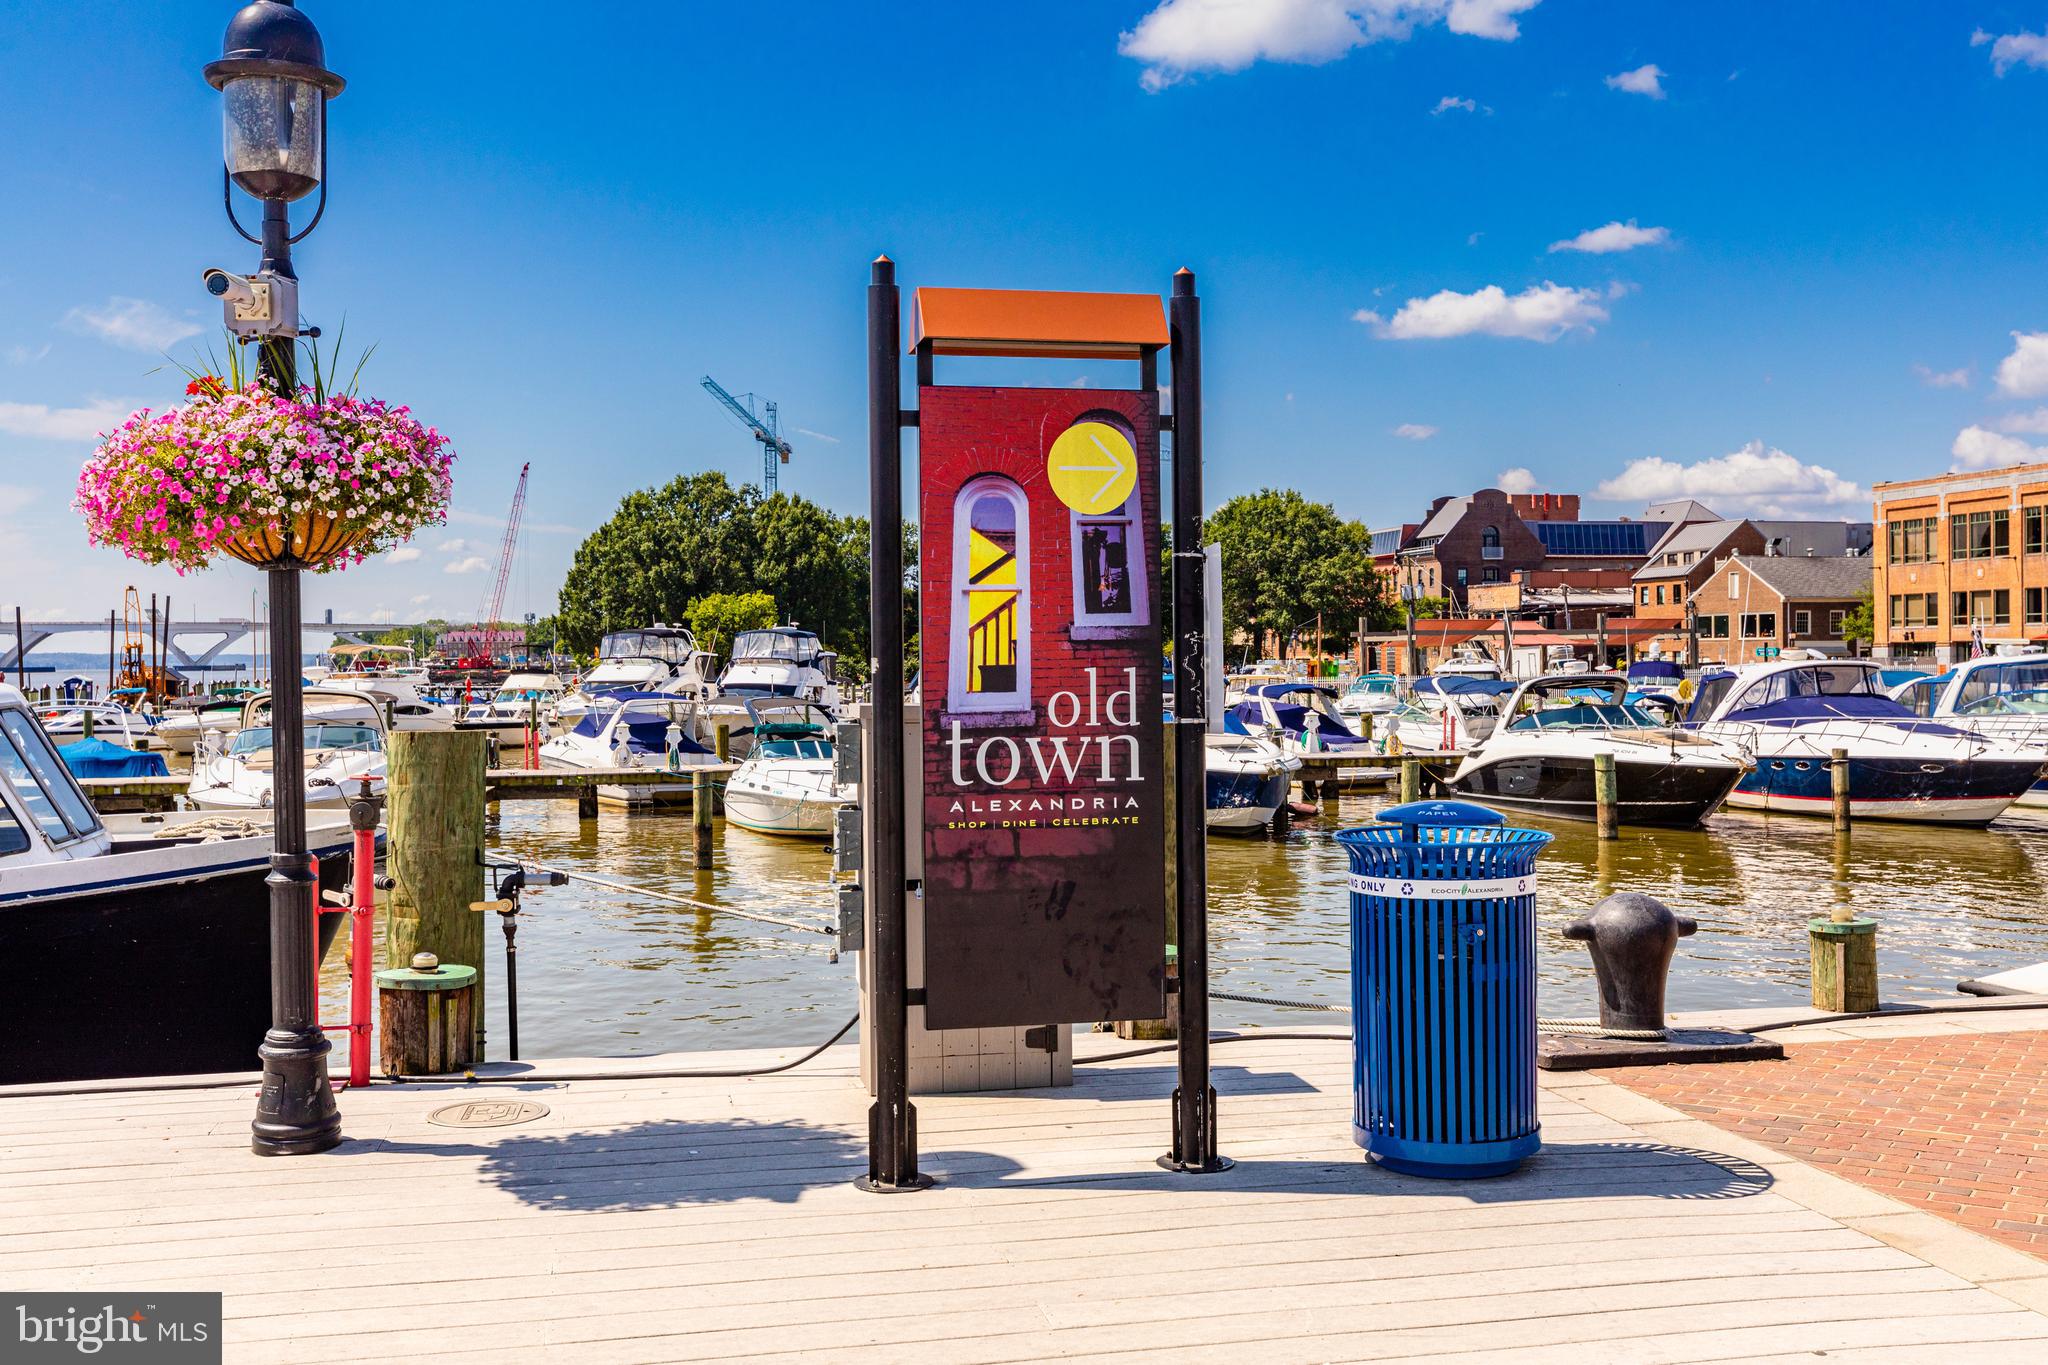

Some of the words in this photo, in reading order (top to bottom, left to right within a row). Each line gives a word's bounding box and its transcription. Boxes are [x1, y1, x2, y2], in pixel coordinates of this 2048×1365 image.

[1048, 667, 1140, 727] old
[945, 720, 1145, 786] town
[950, 796, 1139, 812] ALEXANDRIA
[948, 821, 987, 829] SHOP
[1003, 819, 1037, 828] DINE
[1053, 817, 1139, 826] CELEBRATE
[1361, 880, 1385, 892] ONLY
